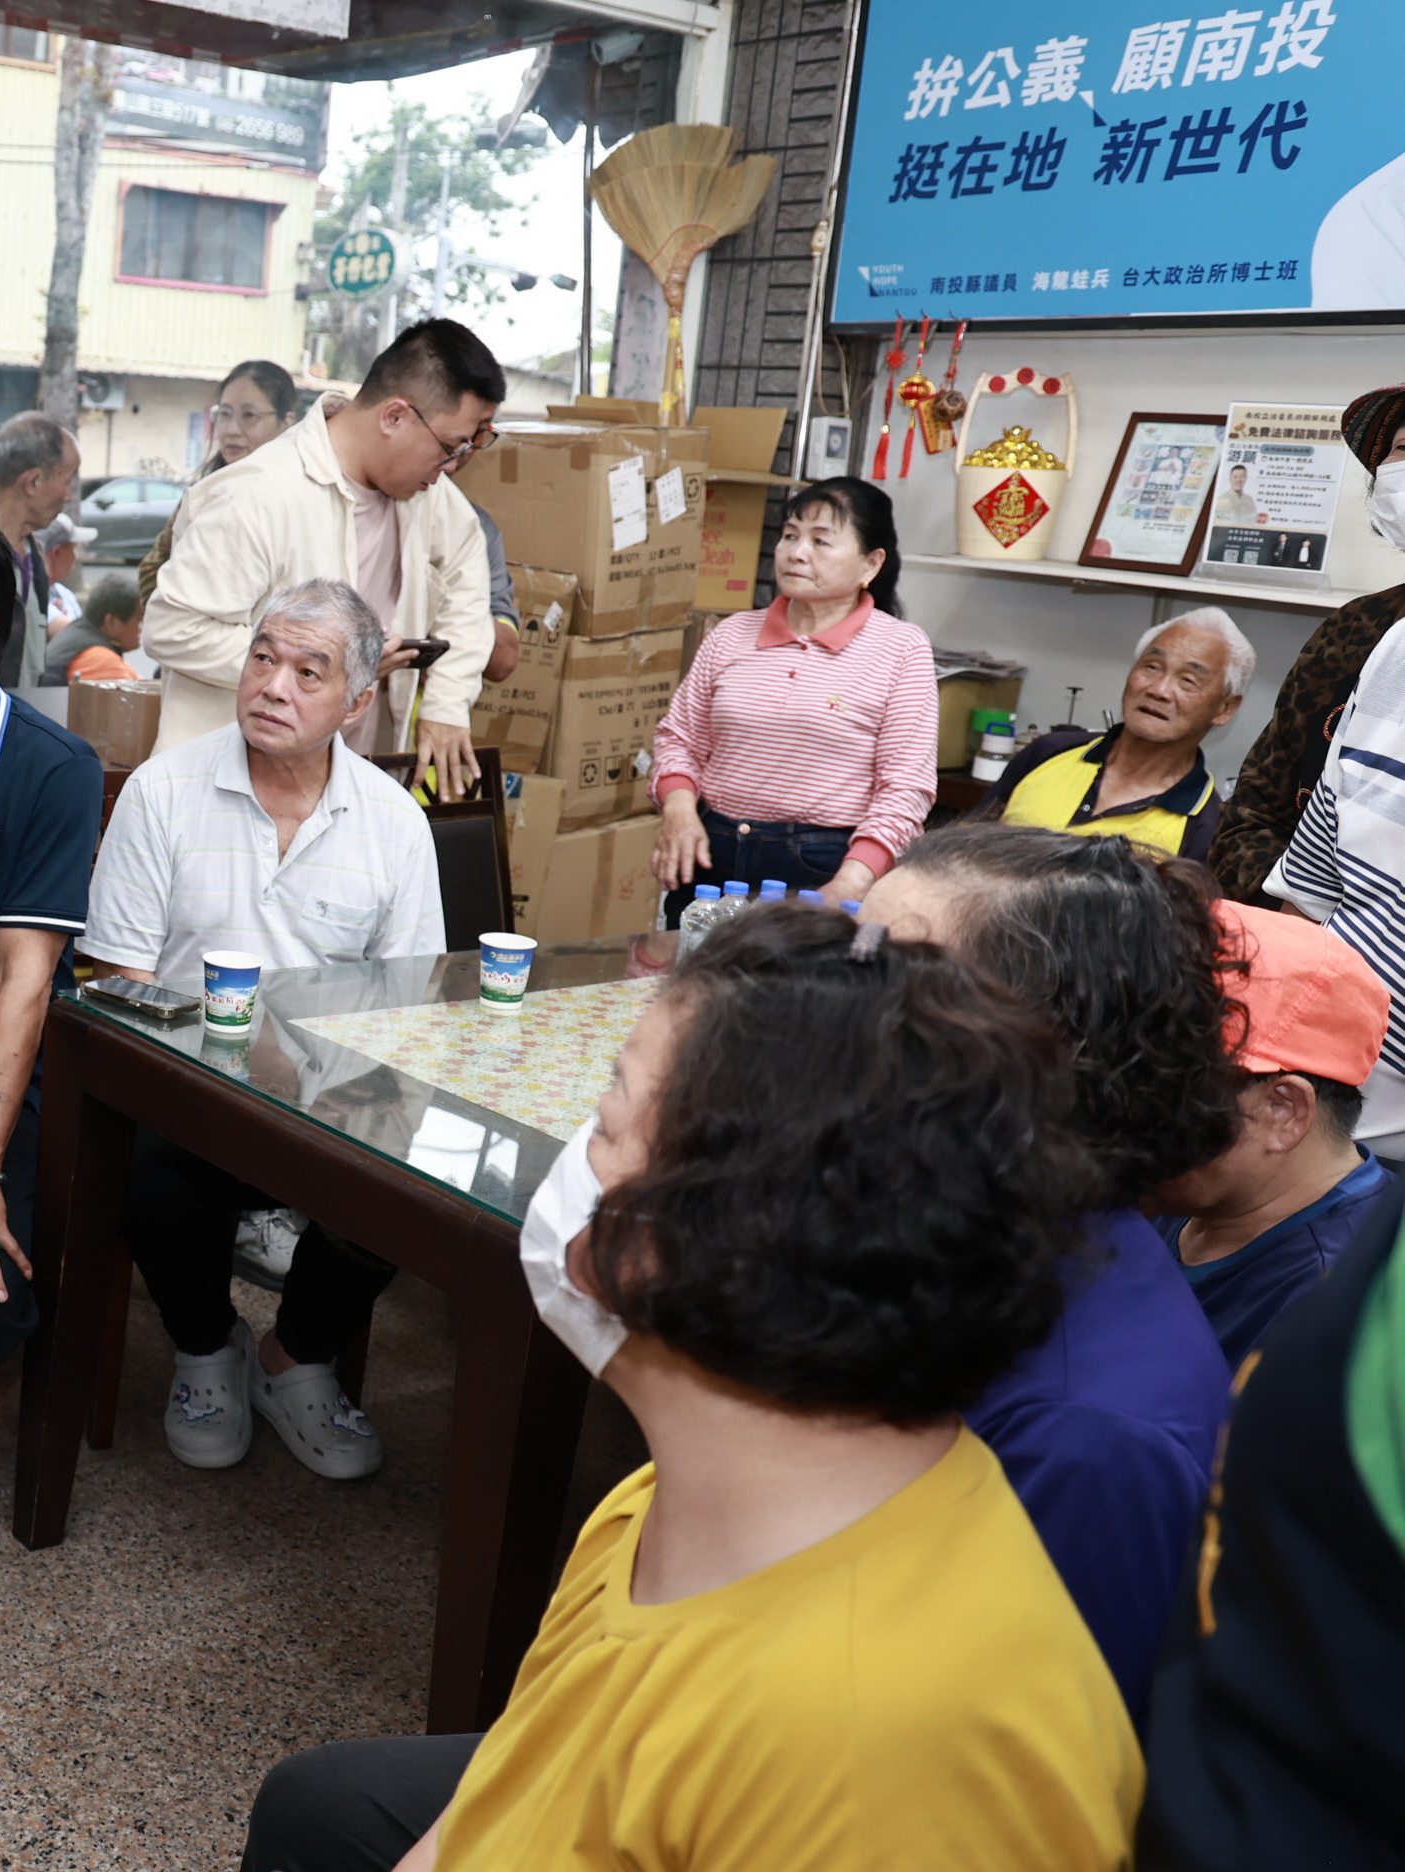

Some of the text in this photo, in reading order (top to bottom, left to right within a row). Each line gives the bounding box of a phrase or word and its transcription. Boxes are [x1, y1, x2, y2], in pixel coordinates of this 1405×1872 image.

[1110, 0, 1338, 95] 顧南投
[888, 99, 1310, 203] 挺在地 新世代
[872, 263, 905, 274] YOUTH
[929, 259, 1299, 295] 南投縣議員 海龍蛙兵 台大政治所博士班
[879, 287, 918, 297] NANTOU
